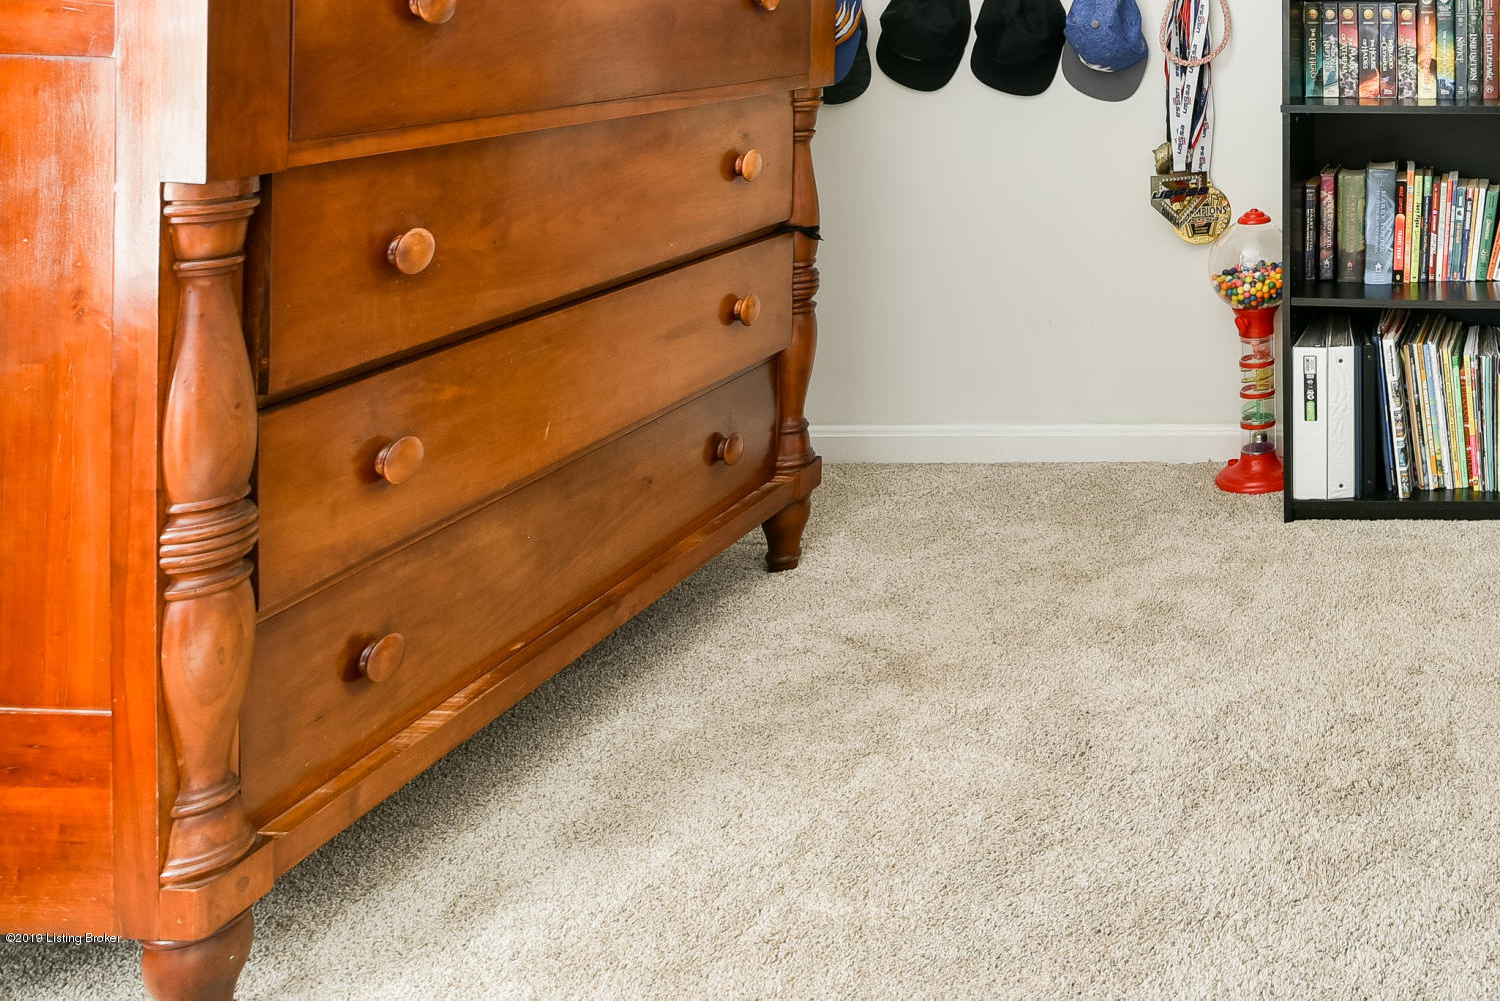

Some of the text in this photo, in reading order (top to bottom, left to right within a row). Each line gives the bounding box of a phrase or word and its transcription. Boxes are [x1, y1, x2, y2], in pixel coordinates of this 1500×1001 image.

[1349, 47, 1357, 72] MARK
[1361, 46, 1369, 69] HADES
[1369, 48, 1377, 69] HOUSE
[1398, 44, 1406, 76] ATHENA
[1407, 47, 1415, 73] MARK
[1456, 36, 1465, 63] NOVICE
[1486, 34, 1495, 82] BATTLEMAGE
[1308, 58, 1316, 78] HERO
